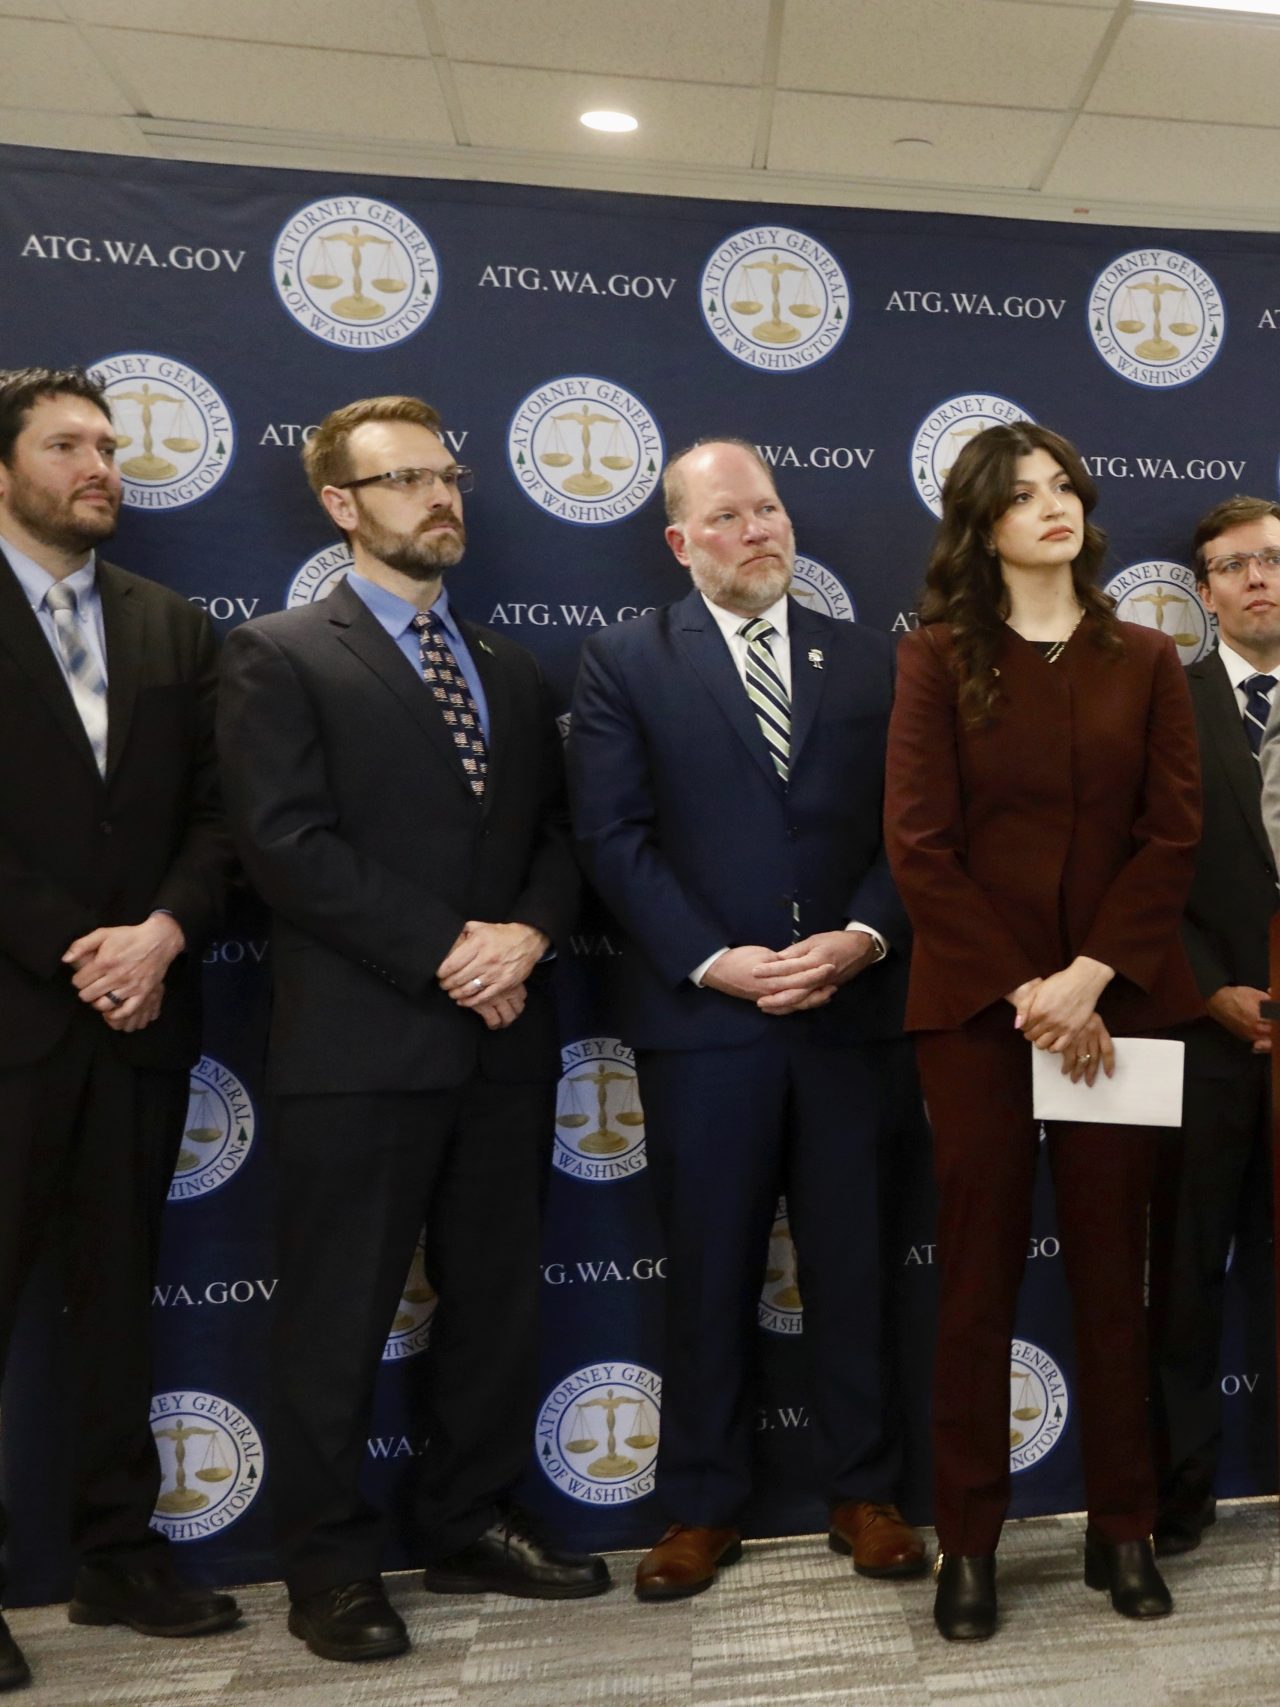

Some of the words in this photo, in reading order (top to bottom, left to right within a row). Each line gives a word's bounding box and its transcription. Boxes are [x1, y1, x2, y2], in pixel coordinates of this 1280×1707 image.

[20, 234, 246, 273] ATG.WA.GOV
[277, 200, 360, 270] ATTORNEY
[367, 204, 434, 278] GENERAL
[478, 265, 677, 299] ATG.WA.GOV
[705, 230, 780, 297] ATTORNEY
[786, 233, 846, 304] GENERAL
[1092, 252, 1161, 316] ATTORNEY
[1166, 255, 1221, 322] GENERAL
[286, 291, 310, 314] OF
[310, 296, 429, 346] WASHINGTON
[885, 290, 1066, 320] ATG.WA.GOV
[712, 317, 734, 339] OF
[732, 322, 841, 369] WASHINGTON
[1098, 335, 1118, 356] OF
[1117, 339, 1216, 384] WASHINGTON
[158, 362, 228, 437] GENERAL
[513, 381, 590, 449] ATTORNEY
[597, 384, 659, 456] GENERAL
[754, 445, 876, 470] WA.GOV
[915, 398, 986, 464] ATTORNEY
[120, 456, 223, 507] SHINGTON
[520, 469, 543, 491] OF
[542, 474, 654, 521] WASHINGTON
[794, 559, 849, 616] GENERA
[1108, 564, 1164, 598] ORNEY
[197, 1058, 251, 1125] ENERAL
[151, 1279, 280, 1307] WA.GOV
[192, 1395, 260, 1462] GENERAL
[539, 1365, 615, 1440] ATTORNEY
[546, 1459, 569, 1480] OF
[152, 1482, 254, 1539] SHINGTON
